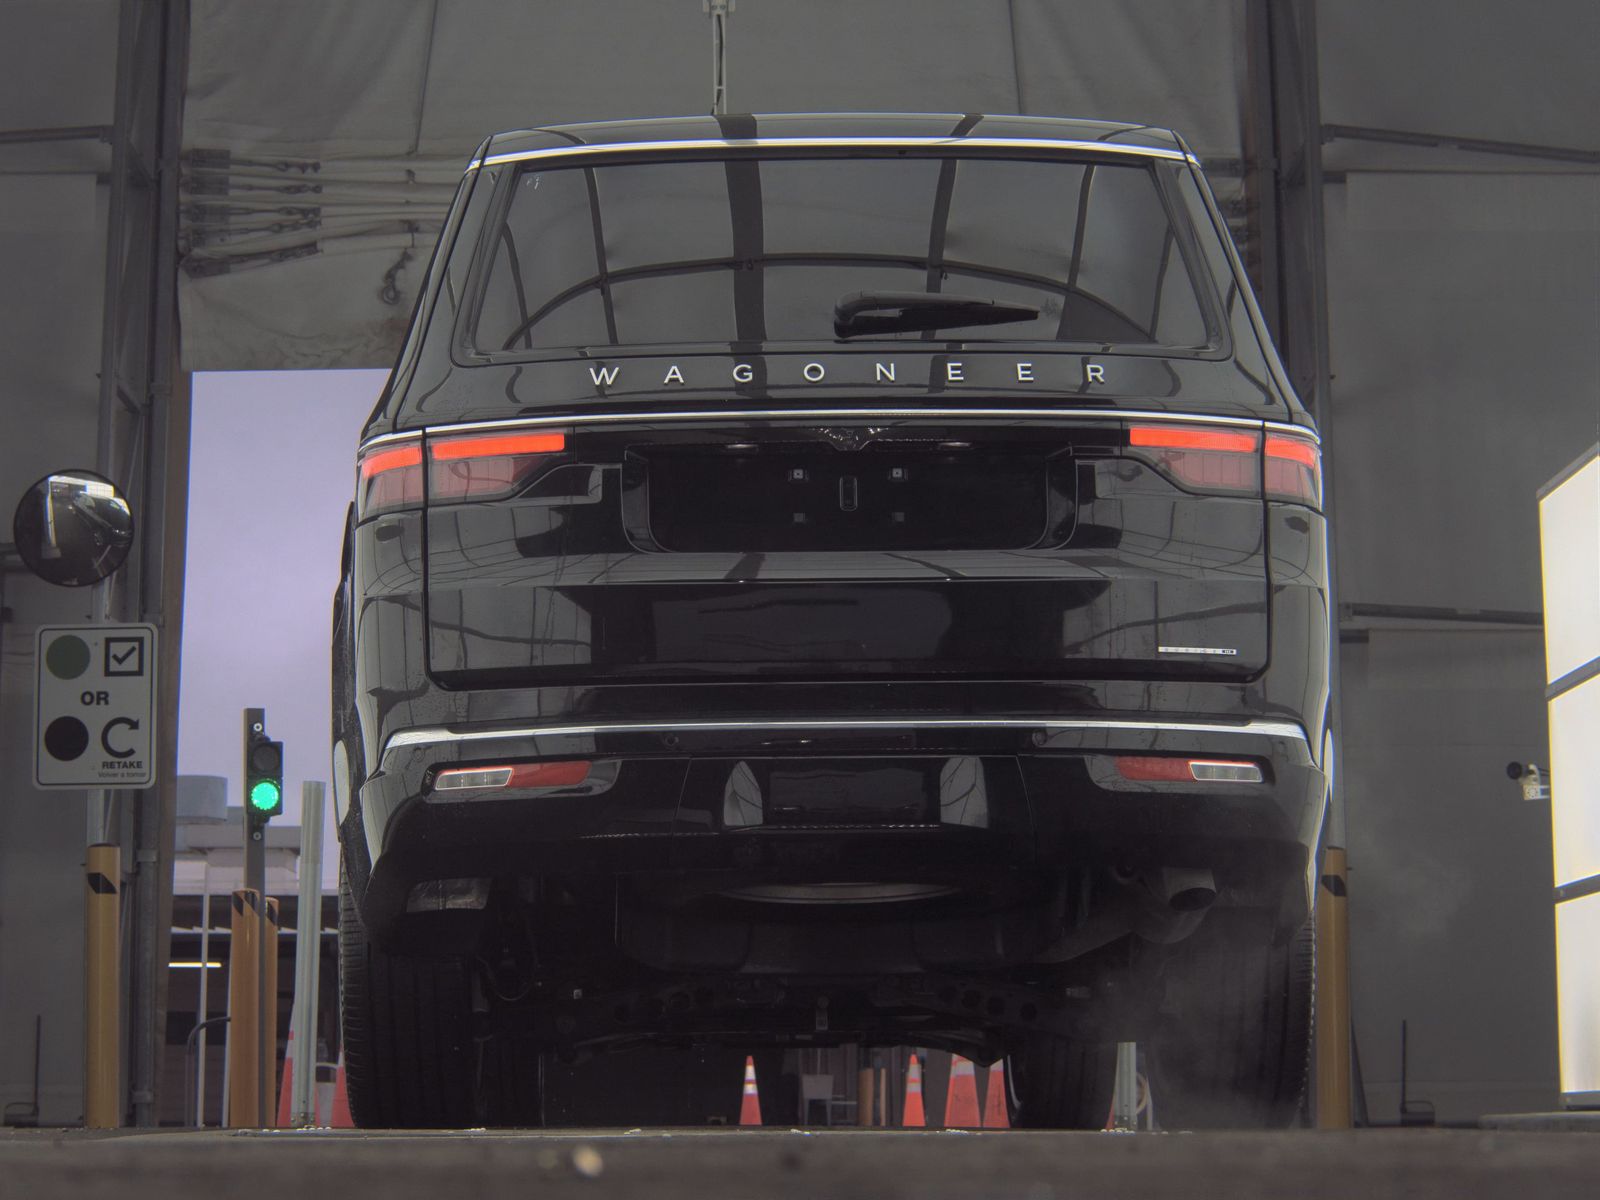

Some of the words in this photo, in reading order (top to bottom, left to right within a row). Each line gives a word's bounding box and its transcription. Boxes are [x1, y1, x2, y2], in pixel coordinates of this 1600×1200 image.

[590, 362, 1105, 386] WAGONEER
[80, 690, 109, 706] OR
[102, 760, 143, 769] RETAKE
